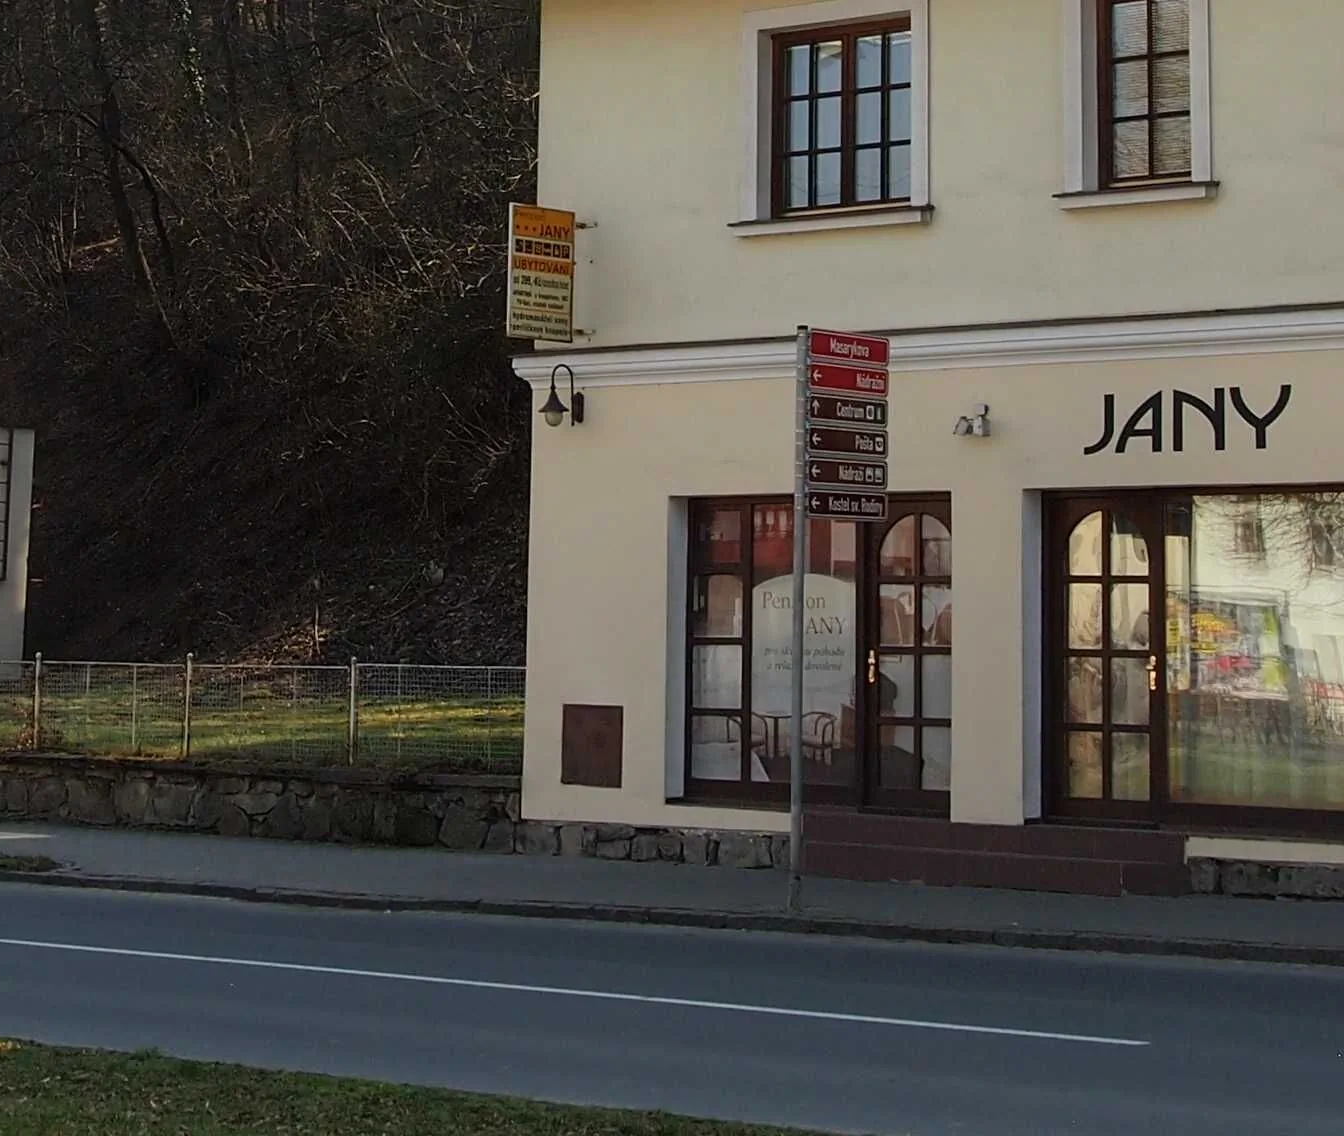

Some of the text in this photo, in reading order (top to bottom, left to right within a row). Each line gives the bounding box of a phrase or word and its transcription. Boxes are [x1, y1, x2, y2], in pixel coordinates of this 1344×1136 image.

[540, 223, 570, 238] JANY
[829, 336, 870, 359] Masarykova
[836, 401, 865, 419] Centrum
[1083, 383, 1292, 455] JANY
[828, 496, 850, 513] Kostel
[761, 591, 826, 610] Penon
